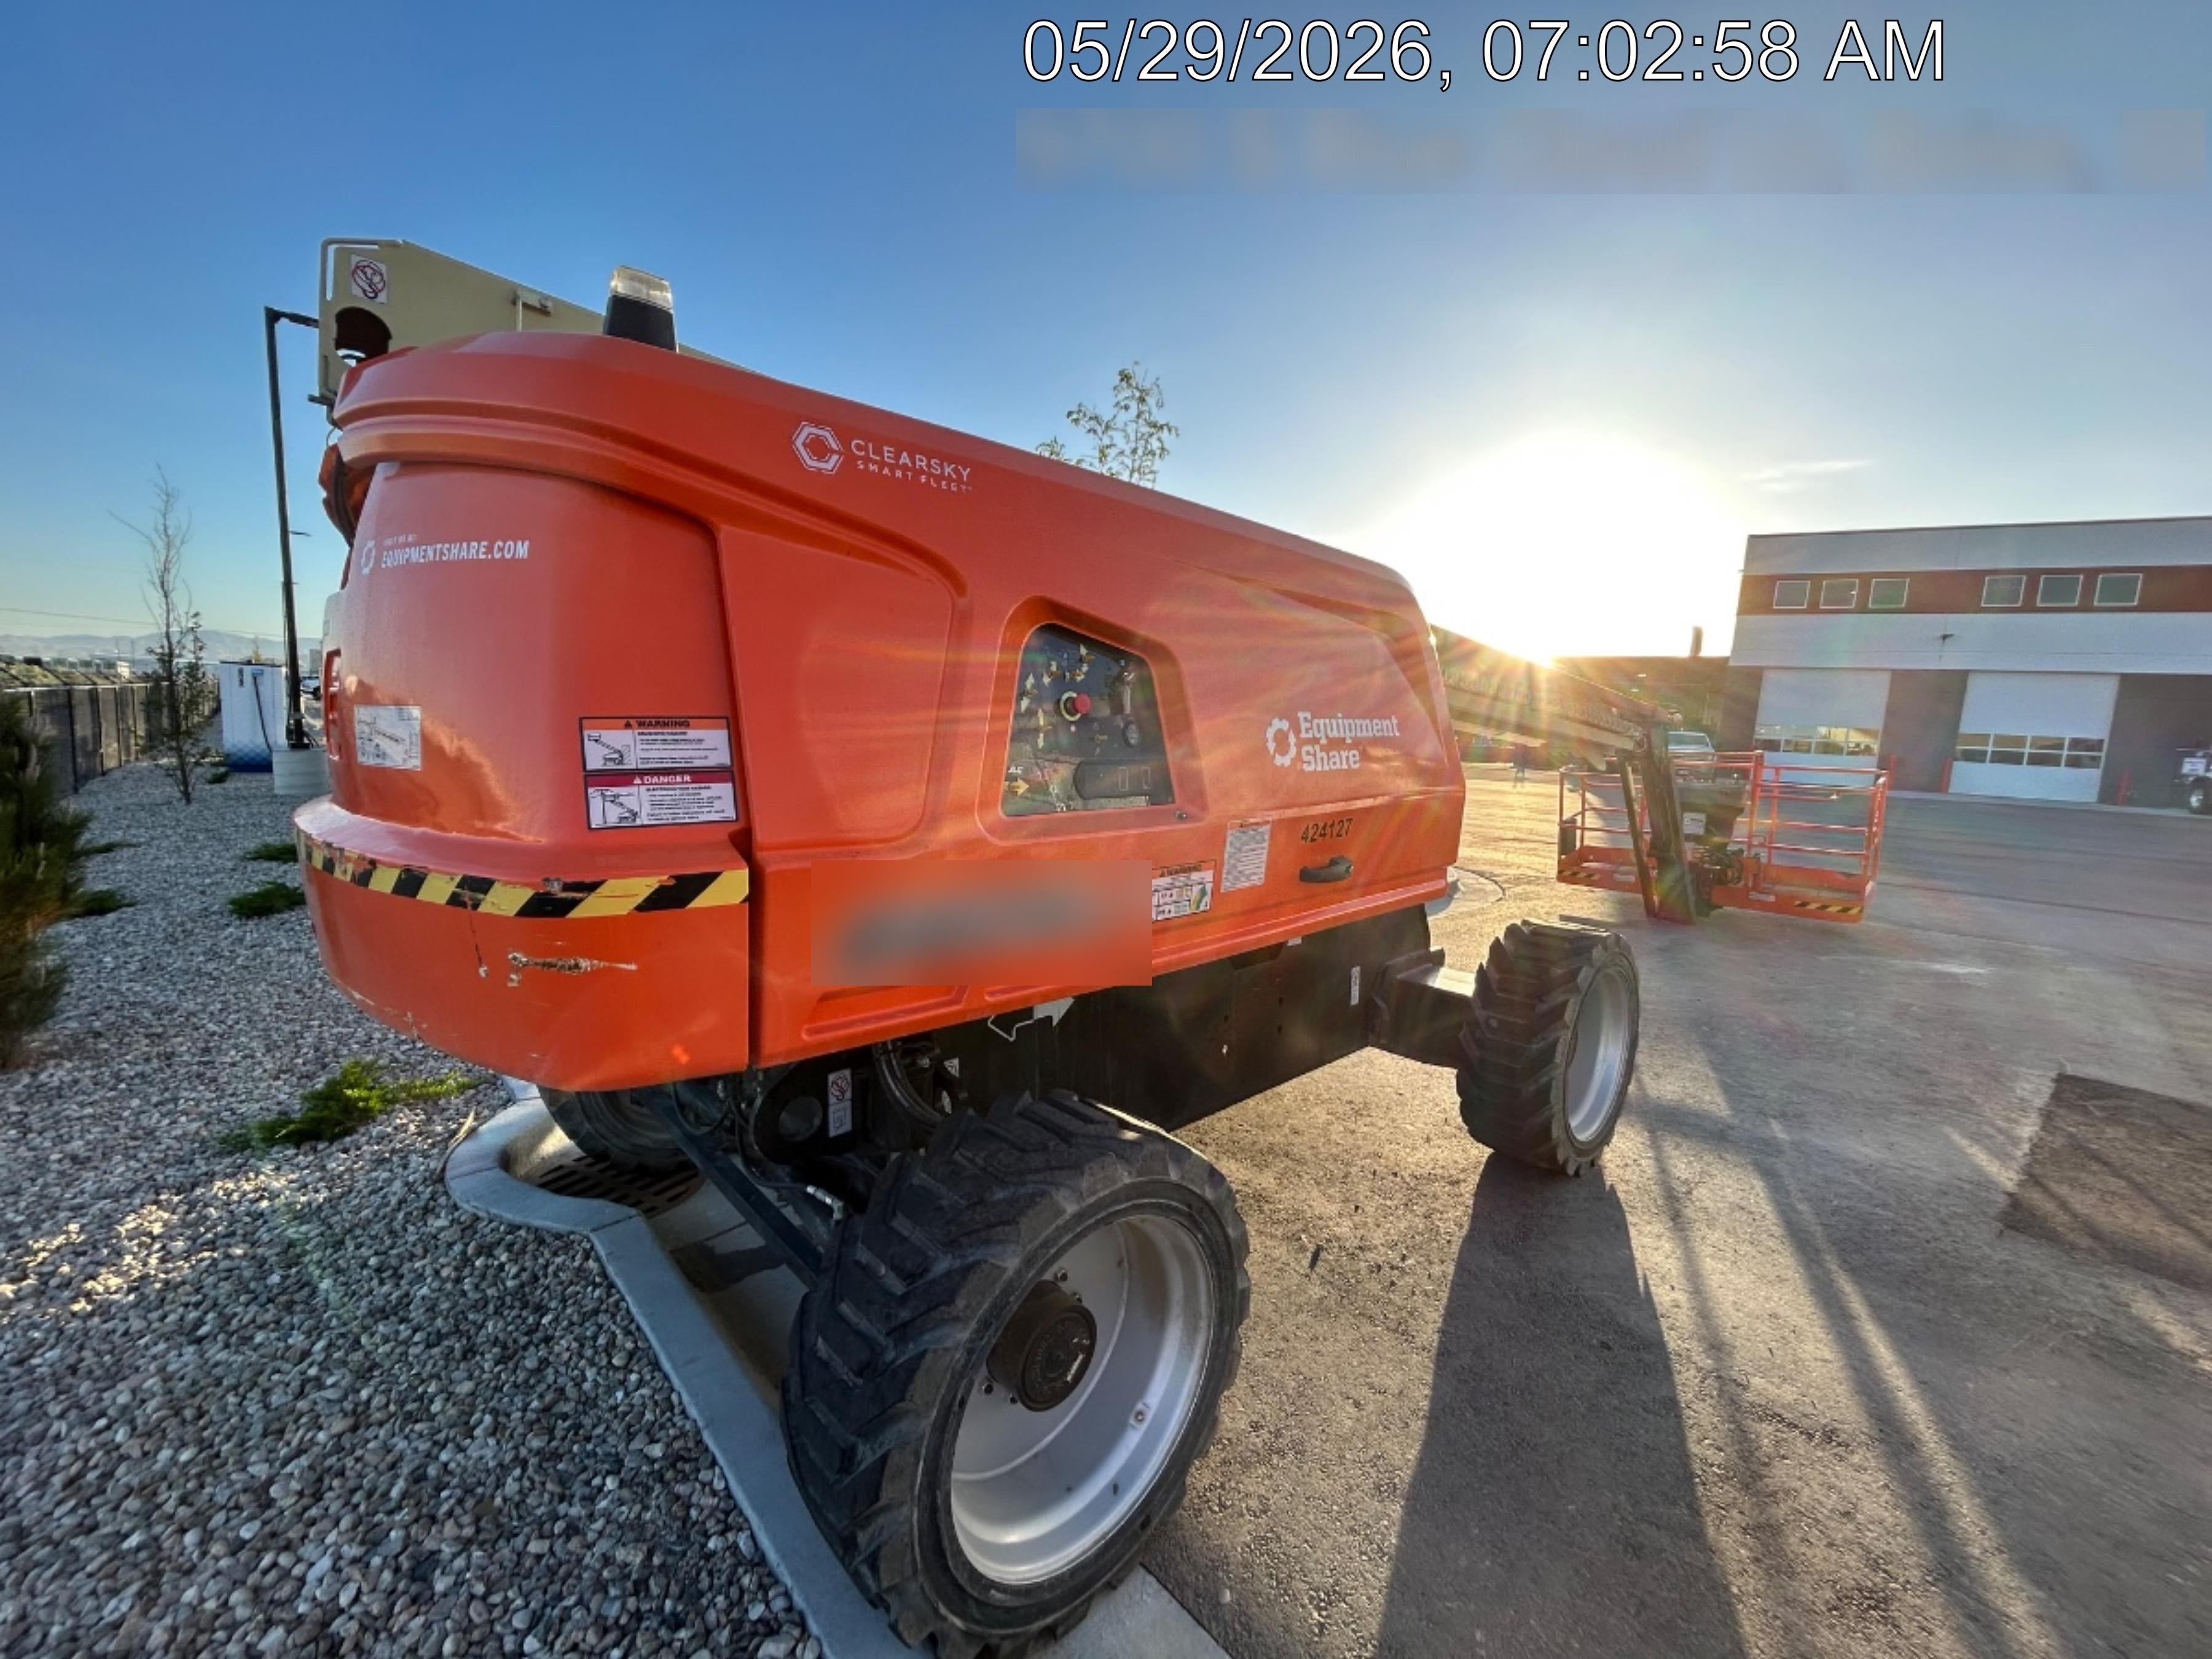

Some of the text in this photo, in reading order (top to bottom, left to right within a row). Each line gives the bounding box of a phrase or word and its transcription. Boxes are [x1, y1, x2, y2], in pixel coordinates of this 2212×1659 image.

[850, 439, 971, 482] CLEARSKY
[856, 460, 913, 481] SMART
[381, 539, 530, 569] EQUIPMENTSHARE.COM
[1297, 711, 1401, 745] Equipment
[1301, 744, 1360, 772] Share
[643, 775, 692, 784] DANGER
[1301, 817, 1354, 844] 424127
